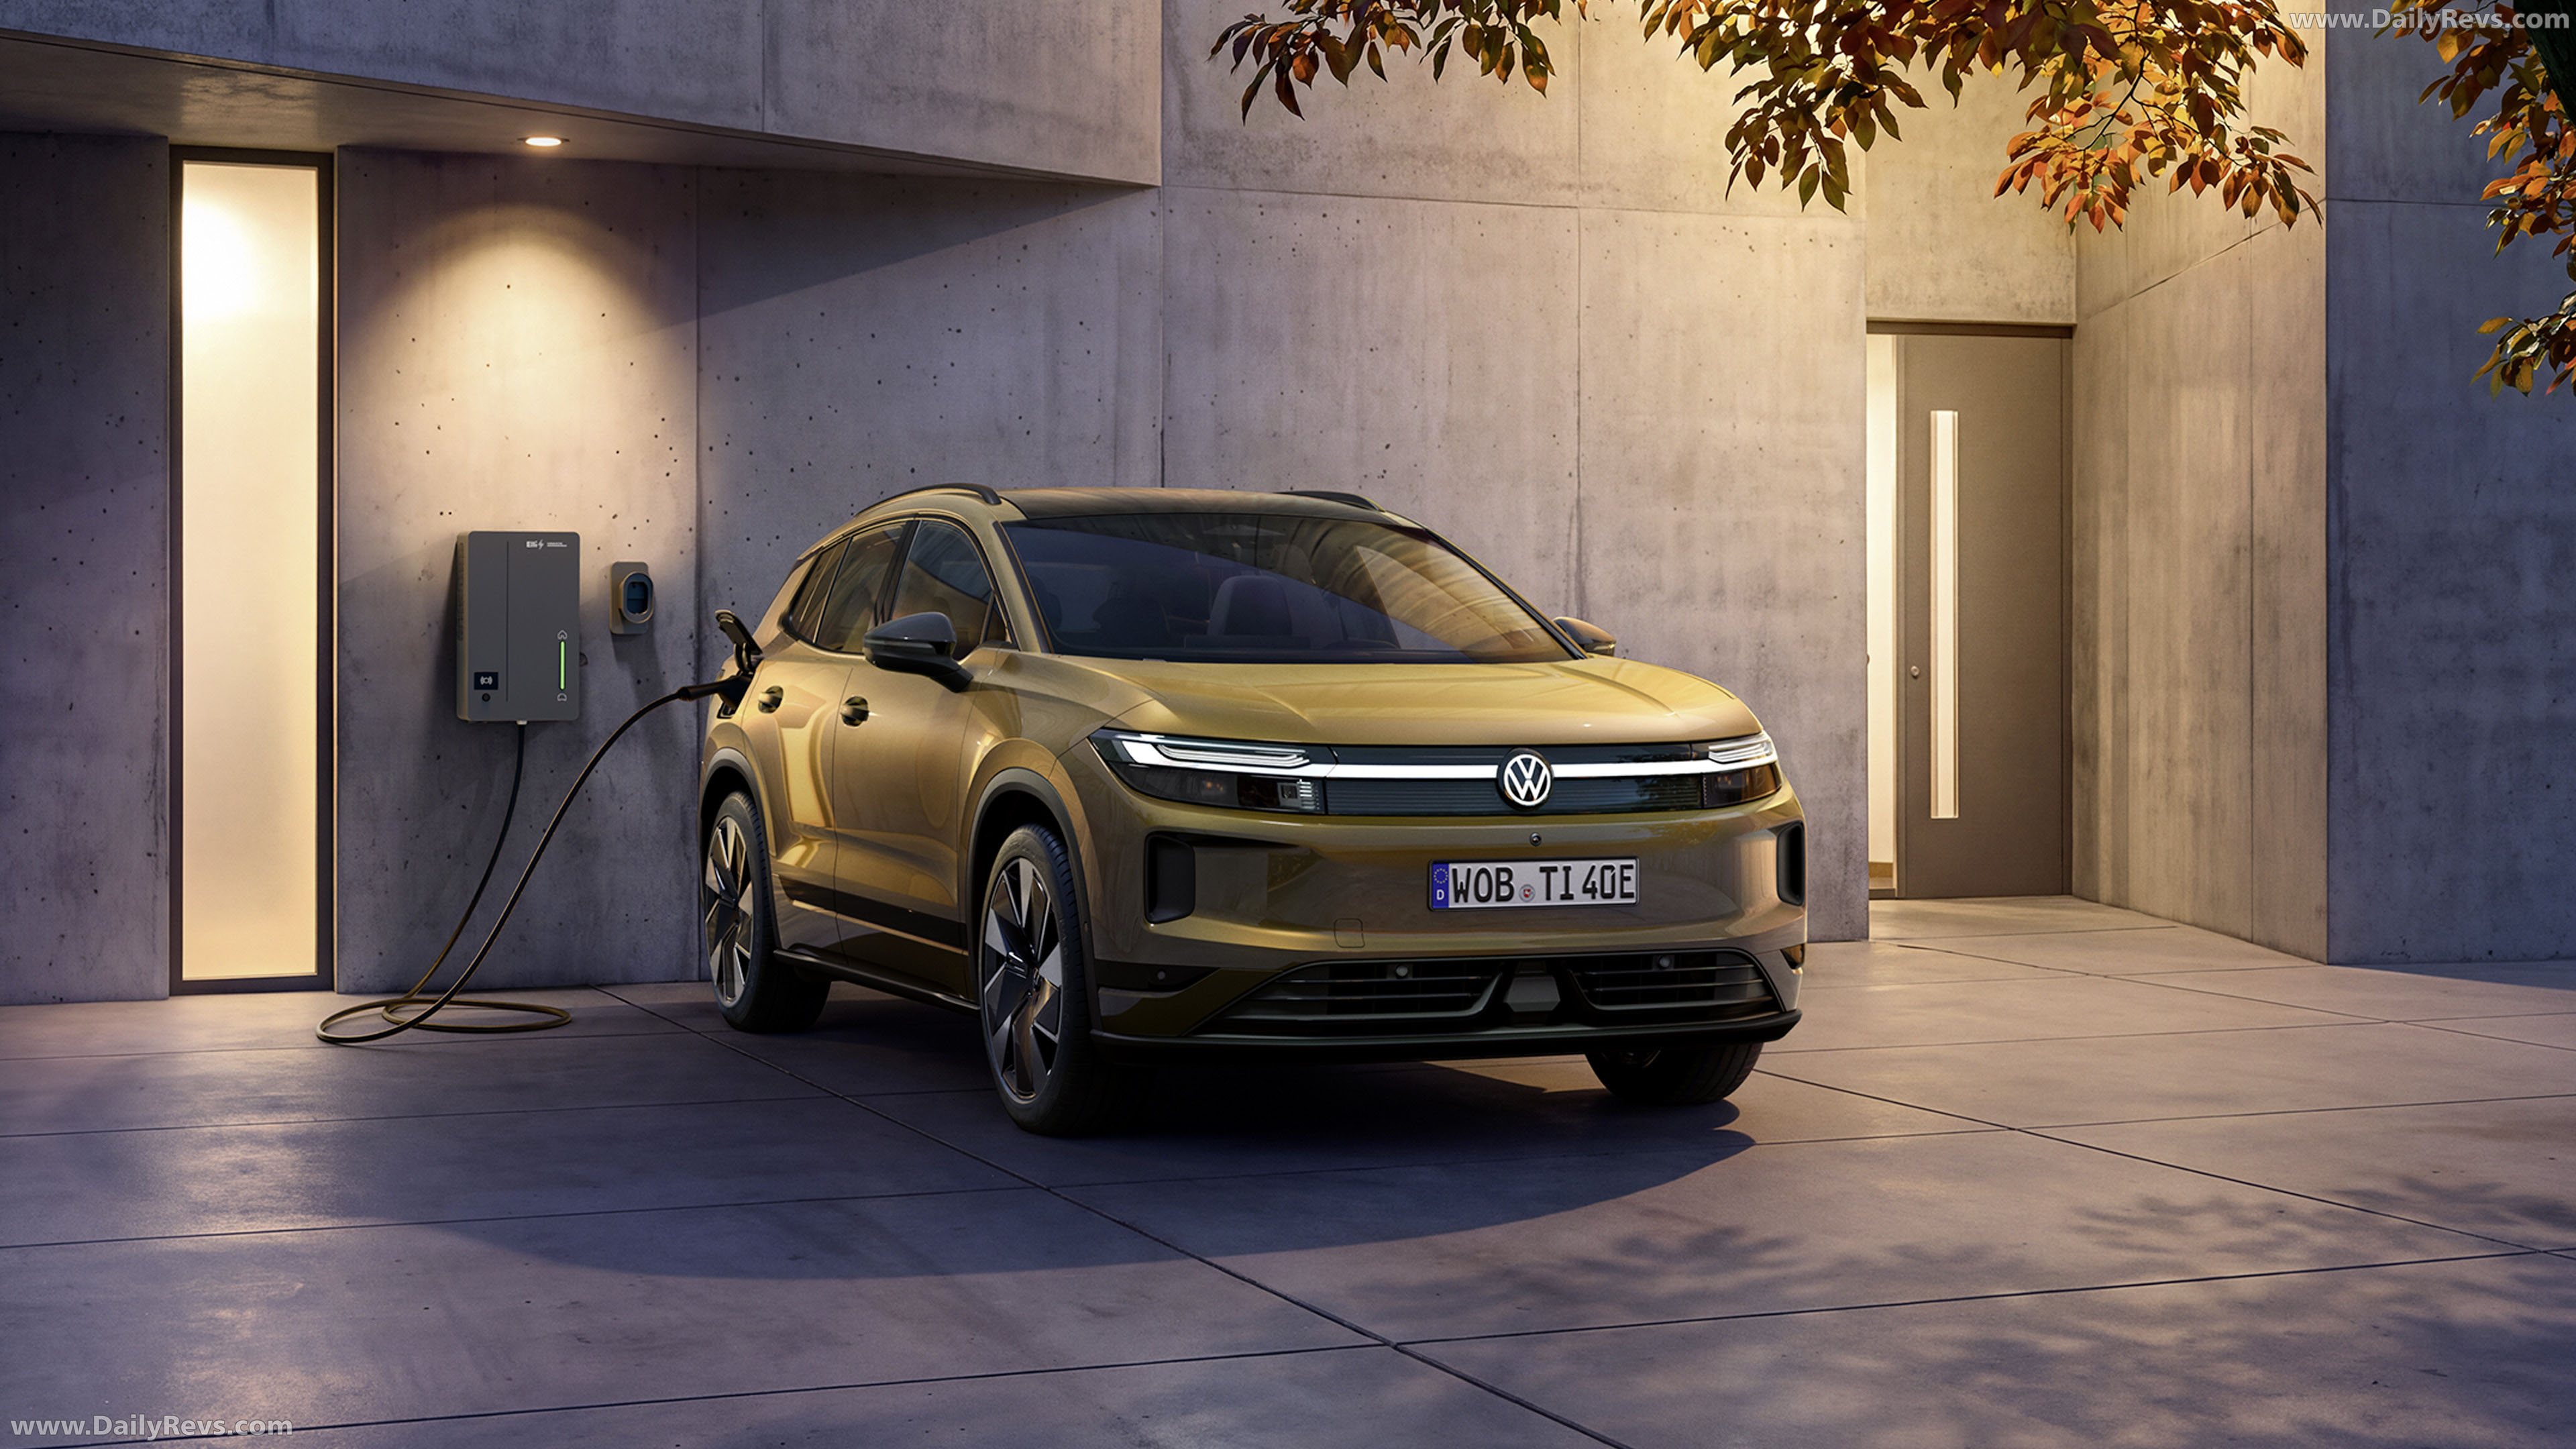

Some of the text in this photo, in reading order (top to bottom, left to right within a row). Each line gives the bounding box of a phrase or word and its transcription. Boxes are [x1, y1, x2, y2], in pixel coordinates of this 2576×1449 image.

[1505, 755, 1550, 804] VW
[1436, 890, 1445, 901] D
[1452, 867, 1515, 904] WOB
